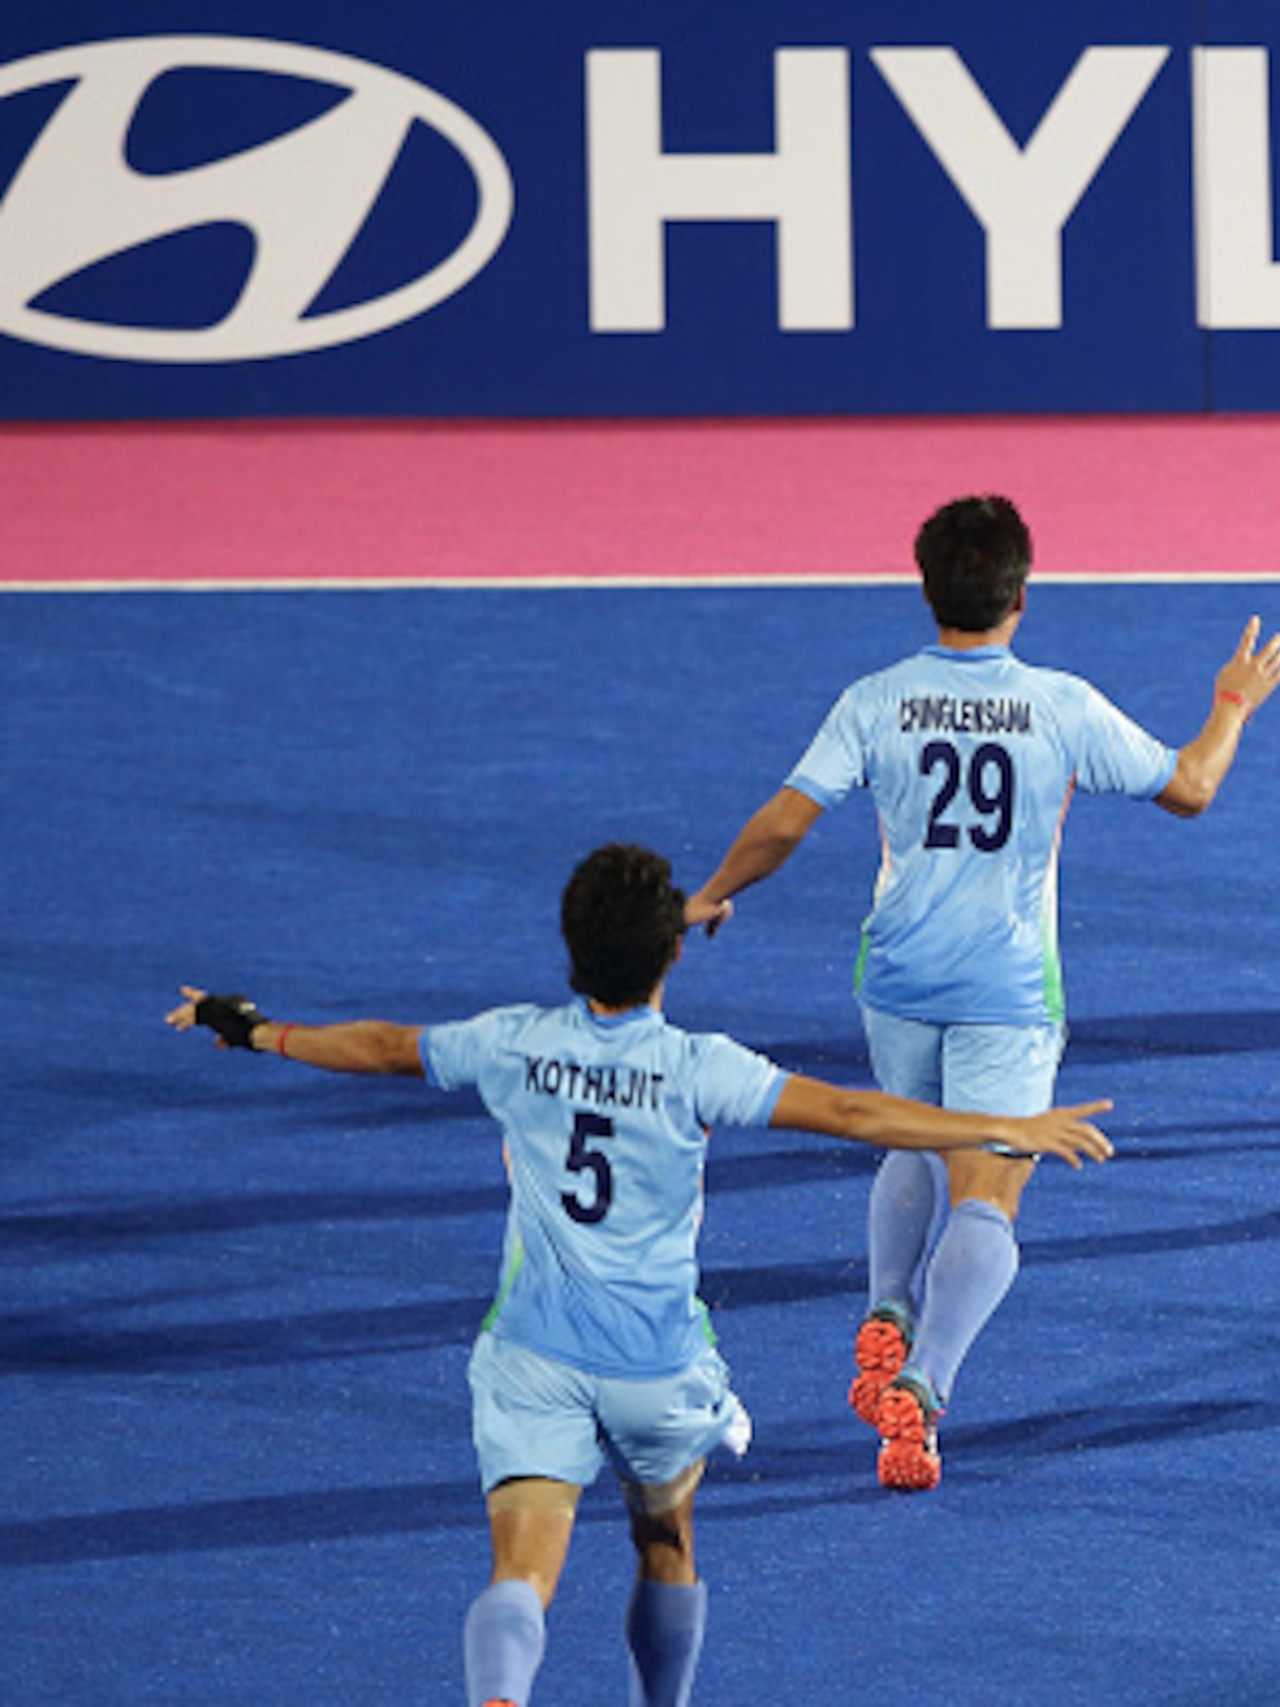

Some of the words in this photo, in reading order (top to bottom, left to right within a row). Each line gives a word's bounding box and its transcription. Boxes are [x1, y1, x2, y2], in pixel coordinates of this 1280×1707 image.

[919, 740, 1016, 852] 29
[525, 1055, 664, 1112] KOTHAJIT
[561, 1111, 615, 1226] 5
